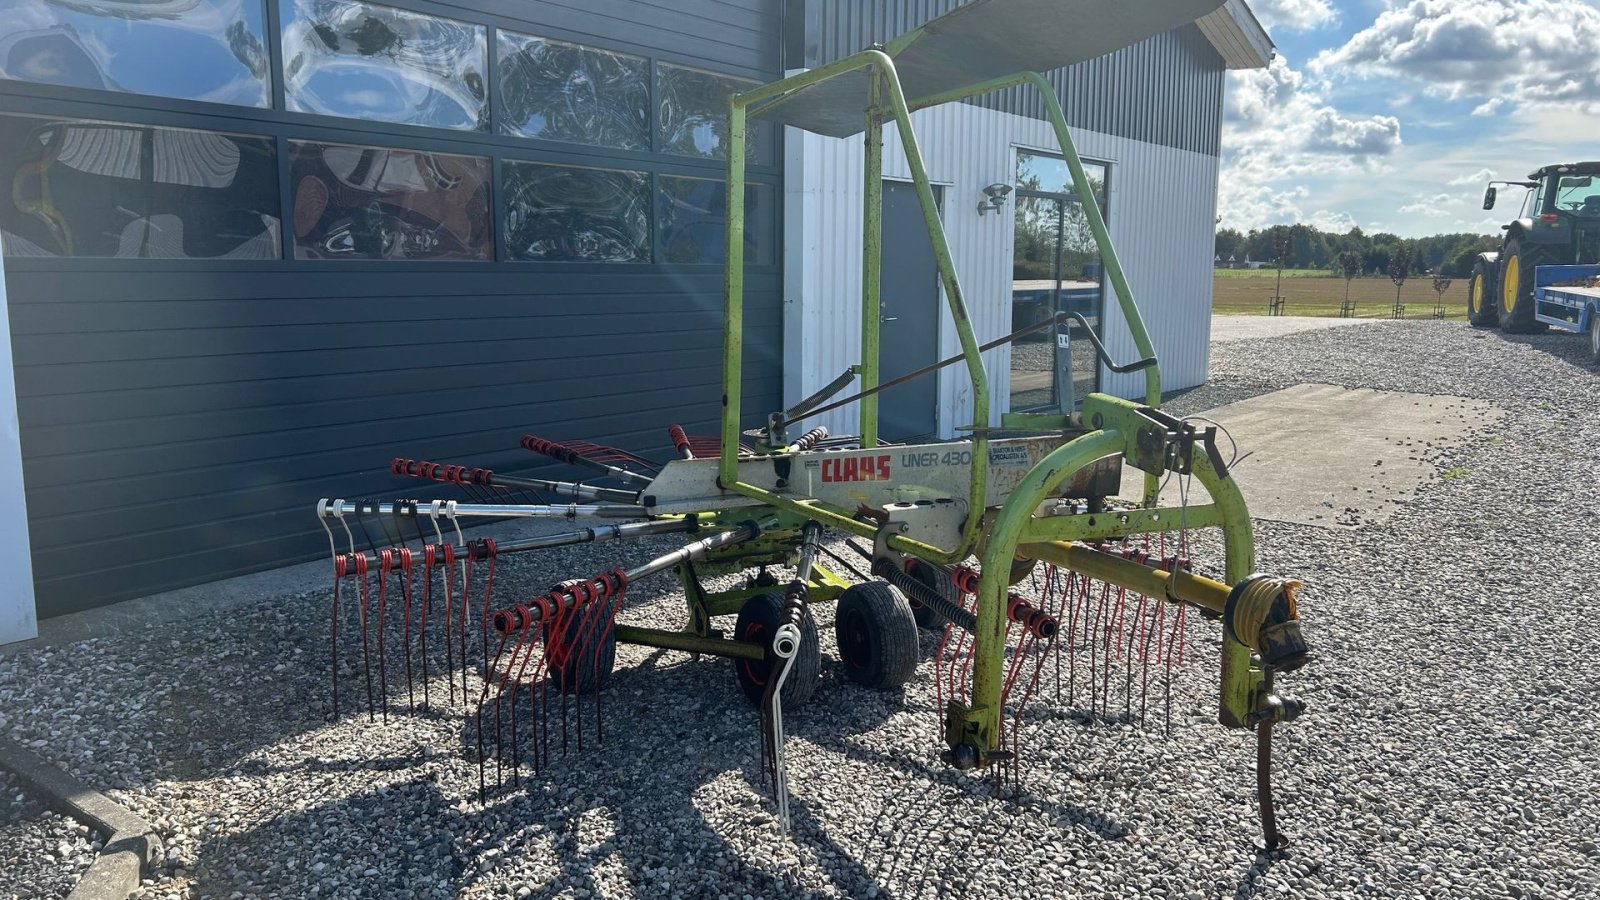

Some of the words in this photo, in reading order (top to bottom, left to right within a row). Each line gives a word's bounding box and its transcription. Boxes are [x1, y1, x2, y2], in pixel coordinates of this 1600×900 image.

[821, 455, 891, 482] CLAAS
[902, 453, 938, 467] LINER
[941, 451, 971, 465] 430
